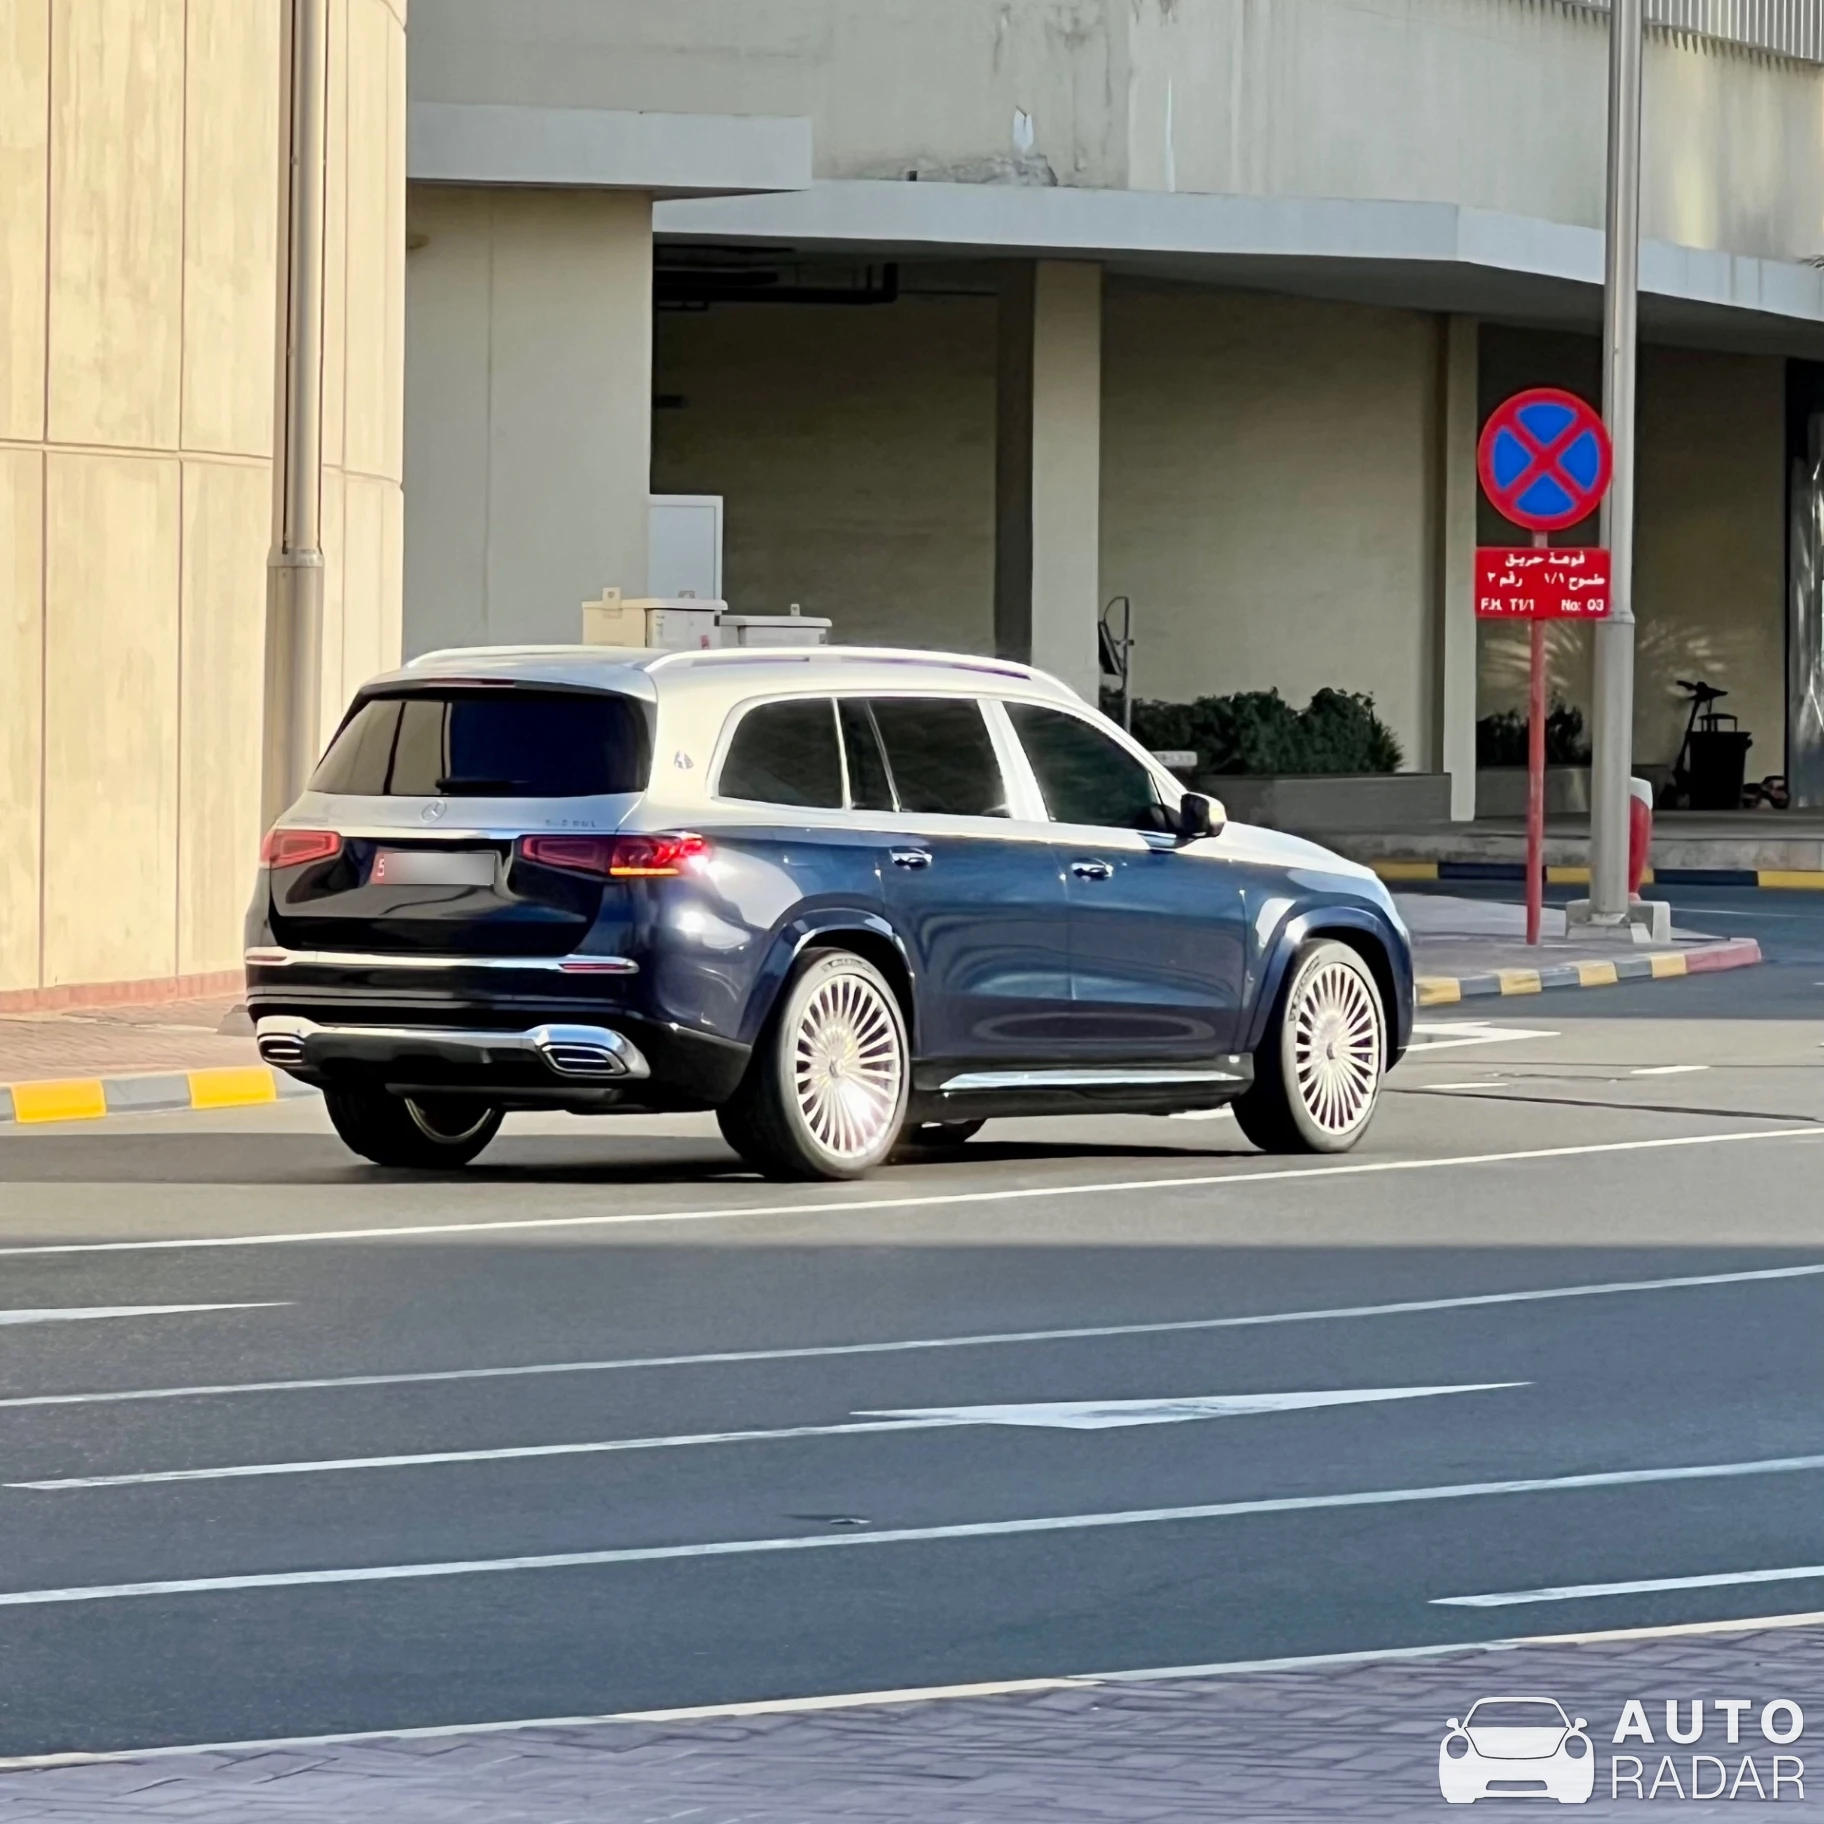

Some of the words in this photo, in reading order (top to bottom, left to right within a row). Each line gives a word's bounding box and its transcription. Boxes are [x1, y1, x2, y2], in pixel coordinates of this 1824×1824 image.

[1505, 552, 1544, 567] حريق
[1499, 570, 1523, 588] رقم
[1561, 599, 1582, 611] No:
[1586, 599, 1605, 611] 03
